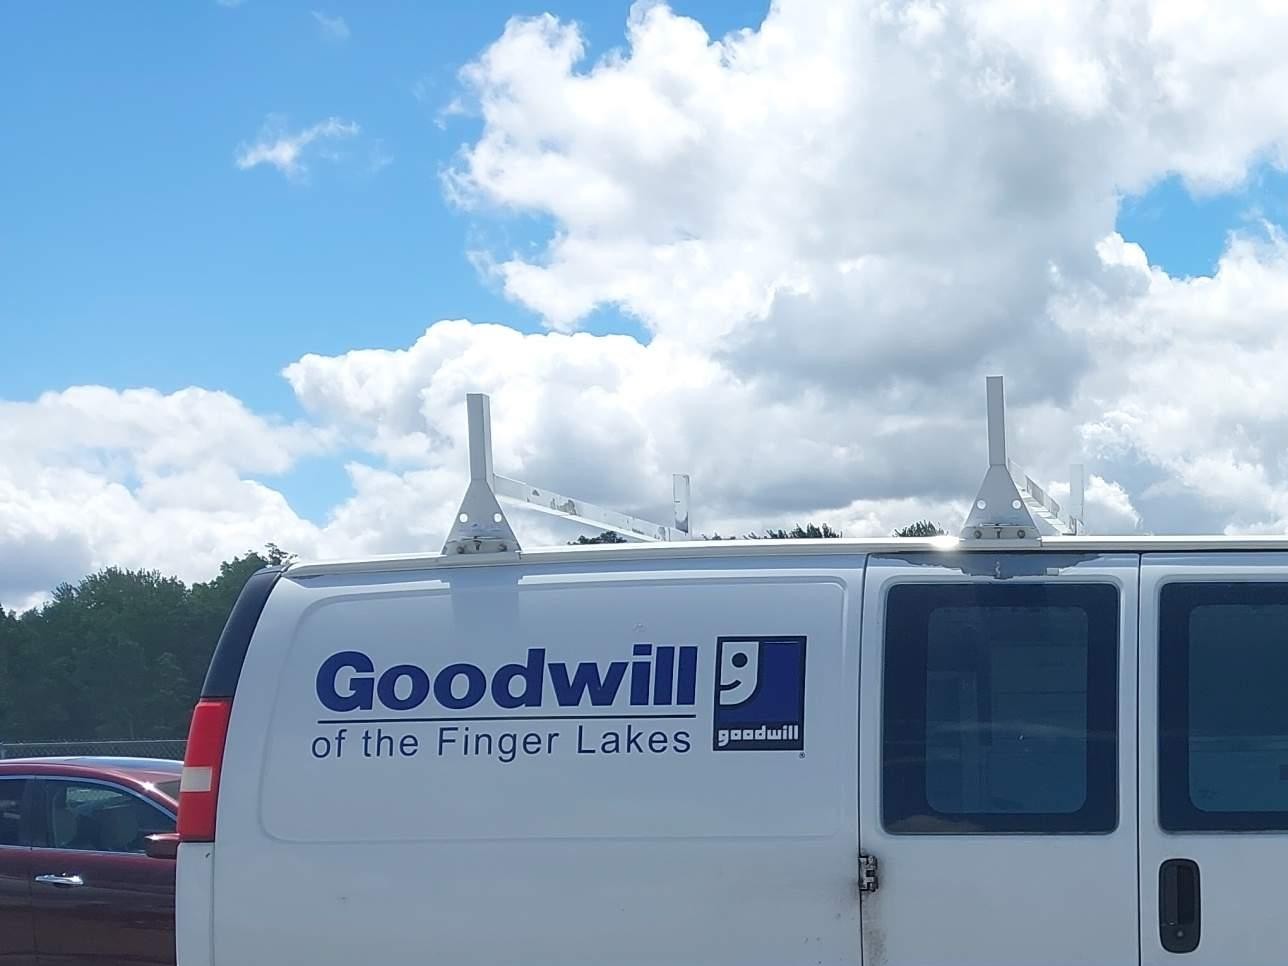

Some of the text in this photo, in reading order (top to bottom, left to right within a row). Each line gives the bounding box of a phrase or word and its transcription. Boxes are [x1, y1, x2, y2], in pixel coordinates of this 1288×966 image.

[315, 643, 699, 712] Goodwill
[311, 724, 691, 763] of the Finger Lakes
[717, 724, 799, 747] goodwill
